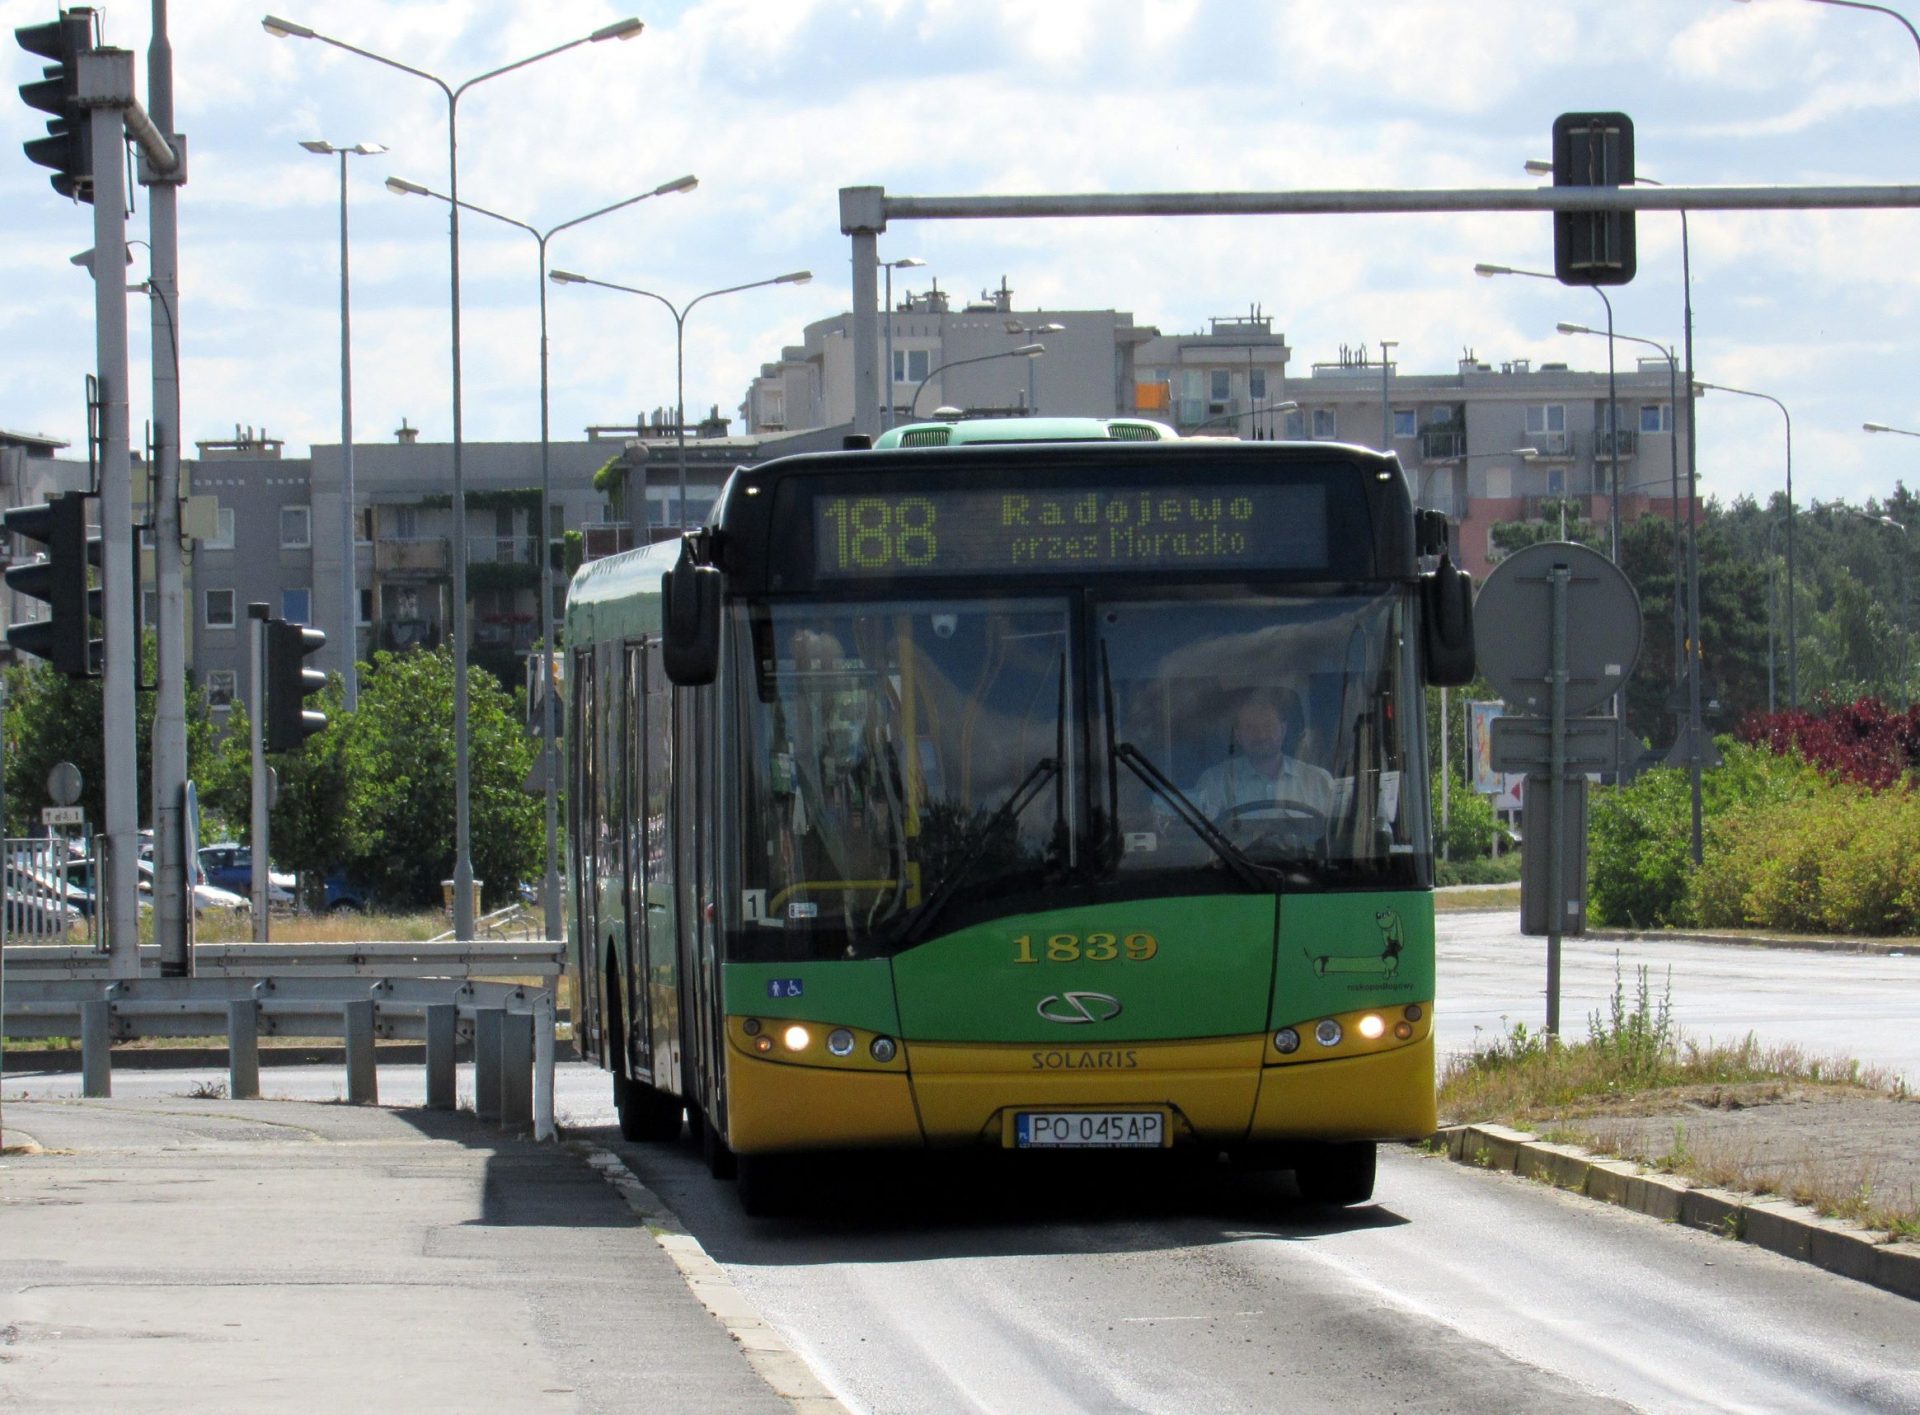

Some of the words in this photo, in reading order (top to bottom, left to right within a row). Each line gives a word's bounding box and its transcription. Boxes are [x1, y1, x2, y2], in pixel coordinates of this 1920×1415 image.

[824, 497, 937, 569] 188
[1002, 491, 1254, 527] Radojewo
[1011, 535, 1098, 564] przez
[1109, 523, 1245, 558] Morasko
[747, 894, 757, 918] 1
[1013, 933, 1158, 964] 1839
[1031, 1050, 1137, 1070] SOLARIS
[1033, 1117, 1070, 1141] PO
